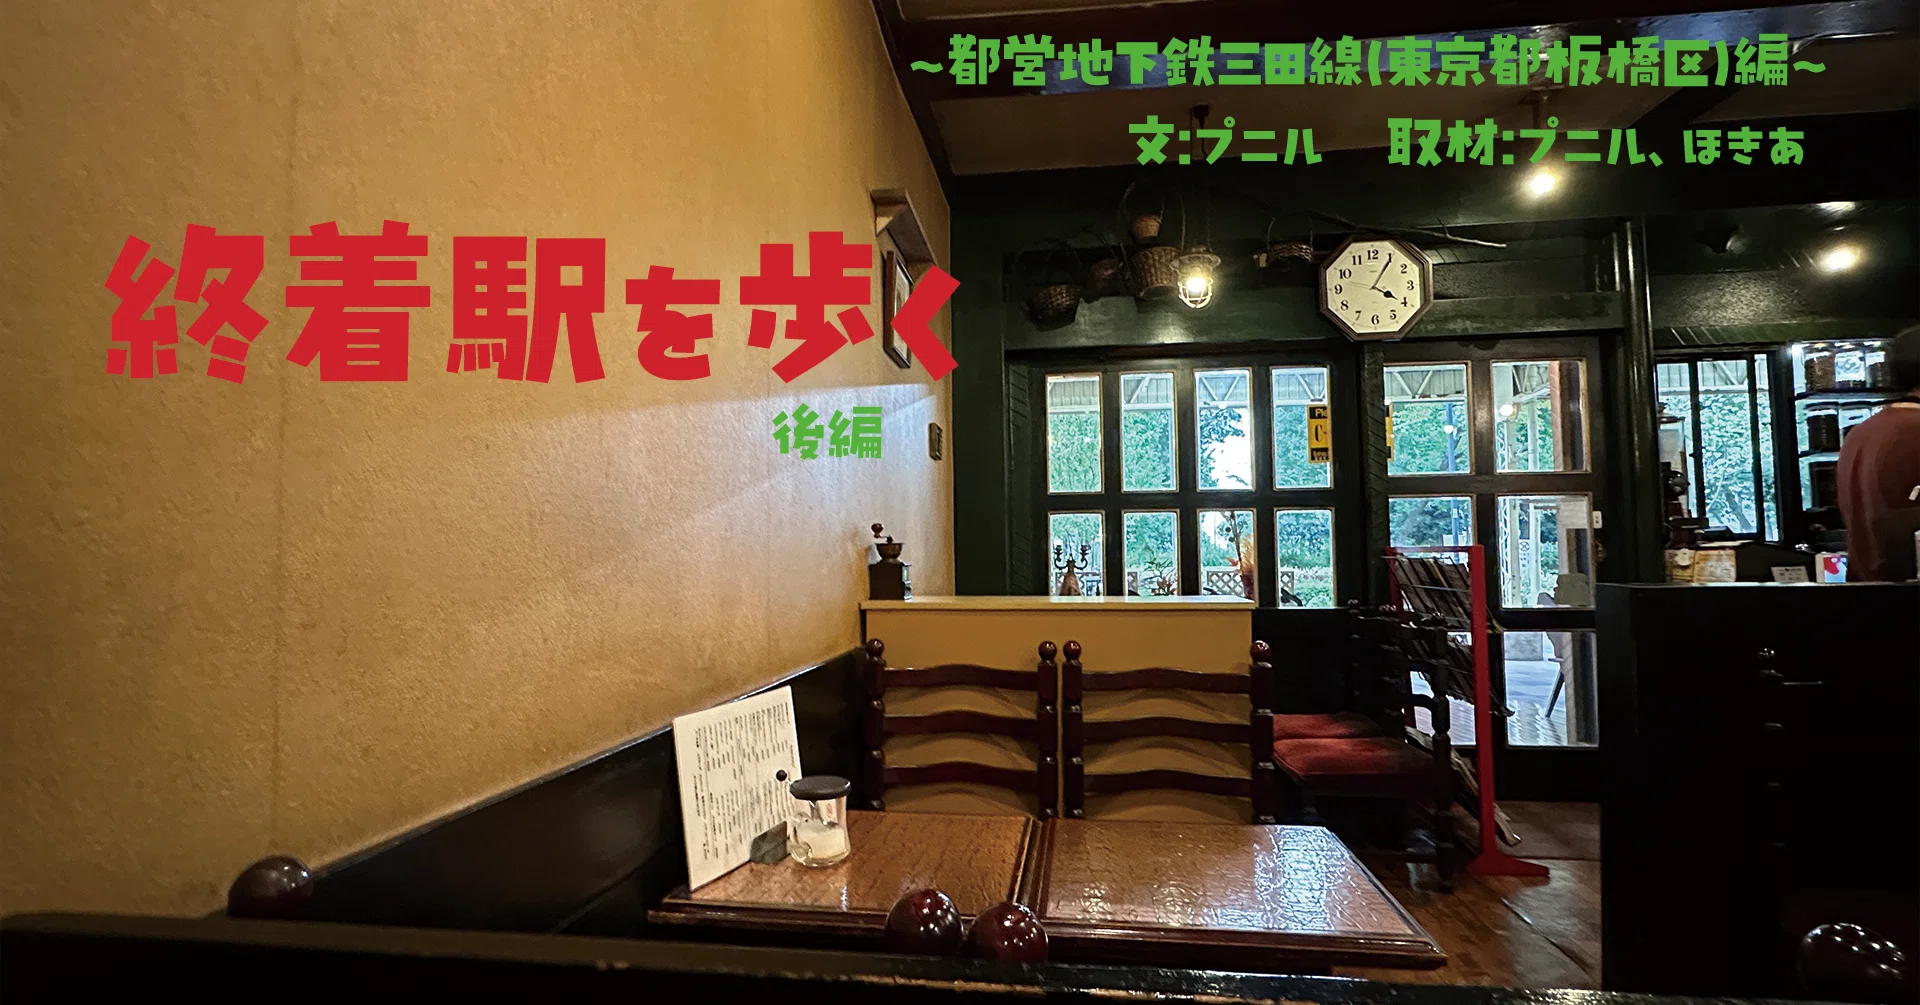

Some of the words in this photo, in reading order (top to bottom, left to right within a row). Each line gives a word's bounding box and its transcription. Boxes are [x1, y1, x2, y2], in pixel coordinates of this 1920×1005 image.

[1367, 249, 1379, 260] 12
[1352, 255, 1362, 265] 11
[1400, 263, 1408, 273] 2
[1339, 269, 1352, 279] 10
[1334, 284, 1343, 294] 9
[1406, 280, 1415, 290] 3
[1340, 300, 1349, 310] 8
[1400, 297, 1408, 307] 4
[1355, 310, 1362, 321] 7
[1371, 314, 1380, 325] 6
[1389, 310, 1397, 320] 5
